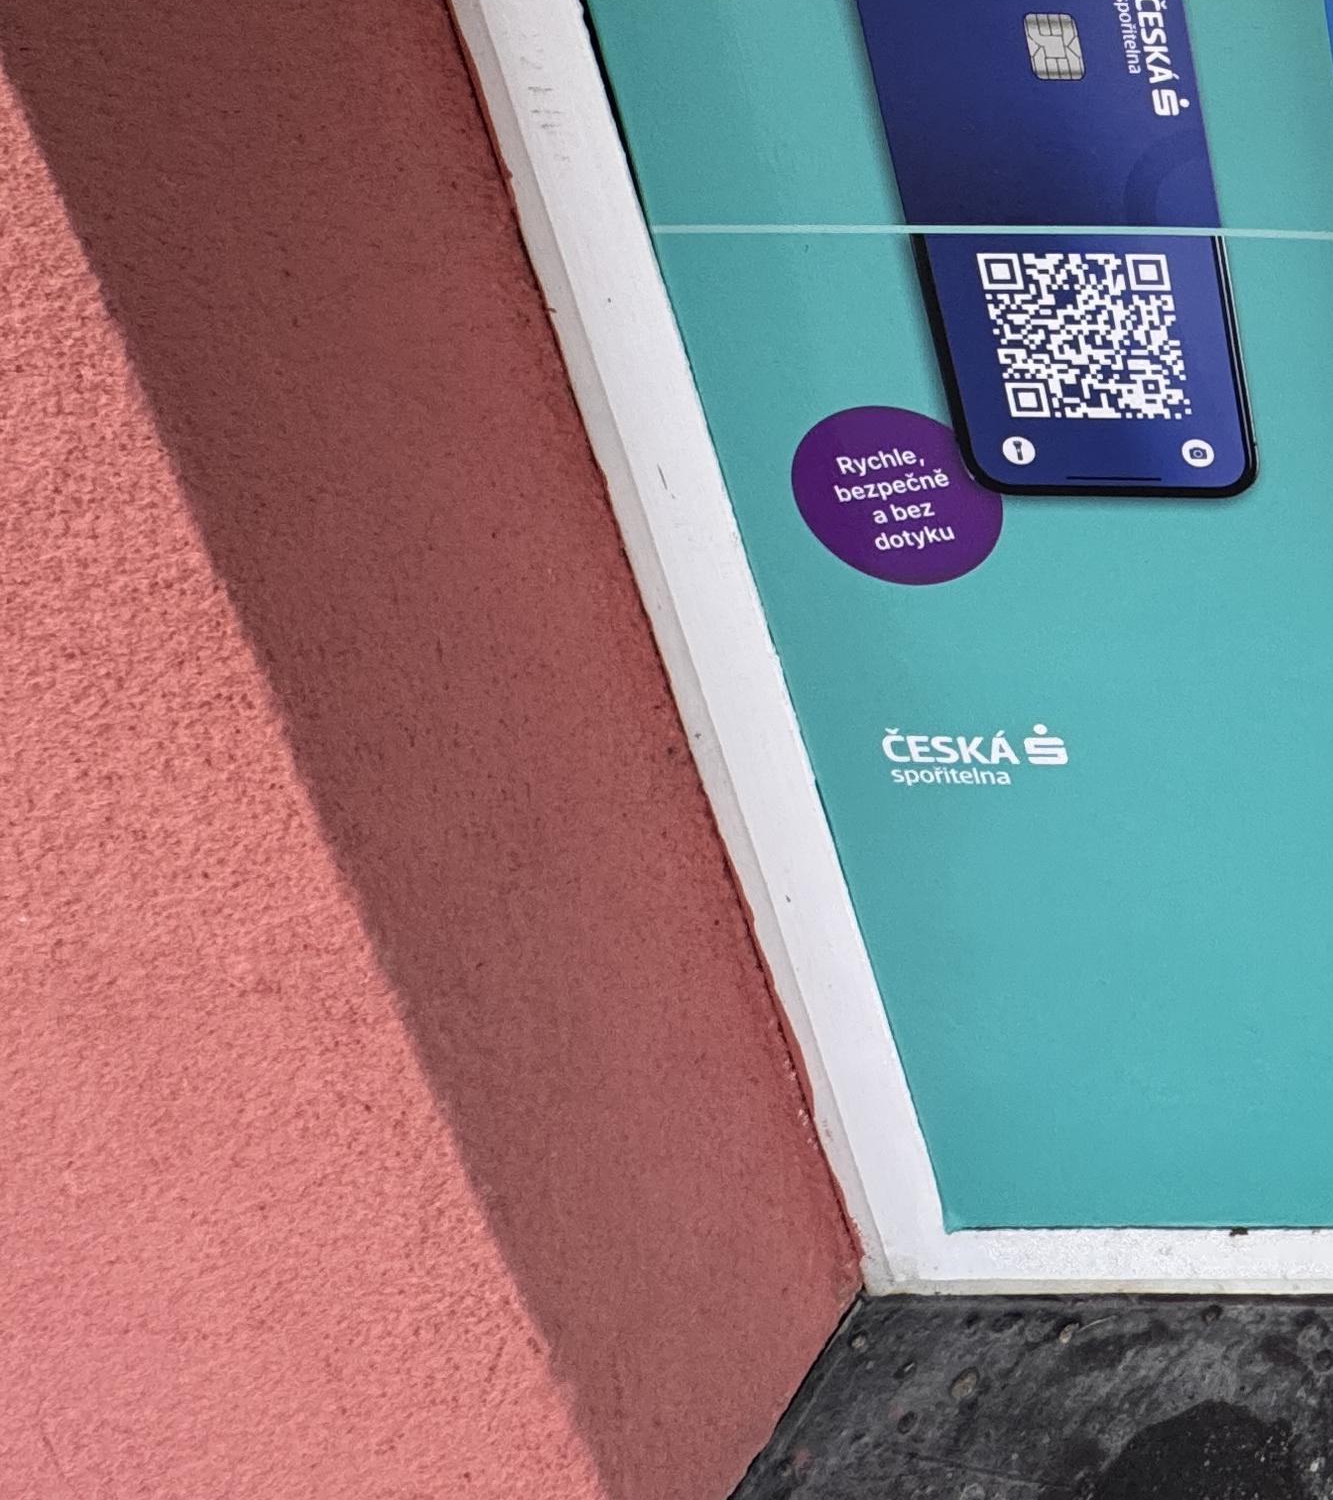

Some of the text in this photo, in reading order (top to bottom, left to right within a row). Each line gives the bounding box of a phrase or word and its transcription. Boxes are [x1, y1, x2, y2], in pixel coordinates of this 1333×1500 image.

[835, 447, 925, 478] Rychle,
[833, 467, 951, 503] bezpečně
[872, 501, 936, 525] a bez
[874, 525, 956, 551] dotyku
[881, 727, 1021, 765] ČESKÁ
[890, 764, 1012, 787] spořitelna
